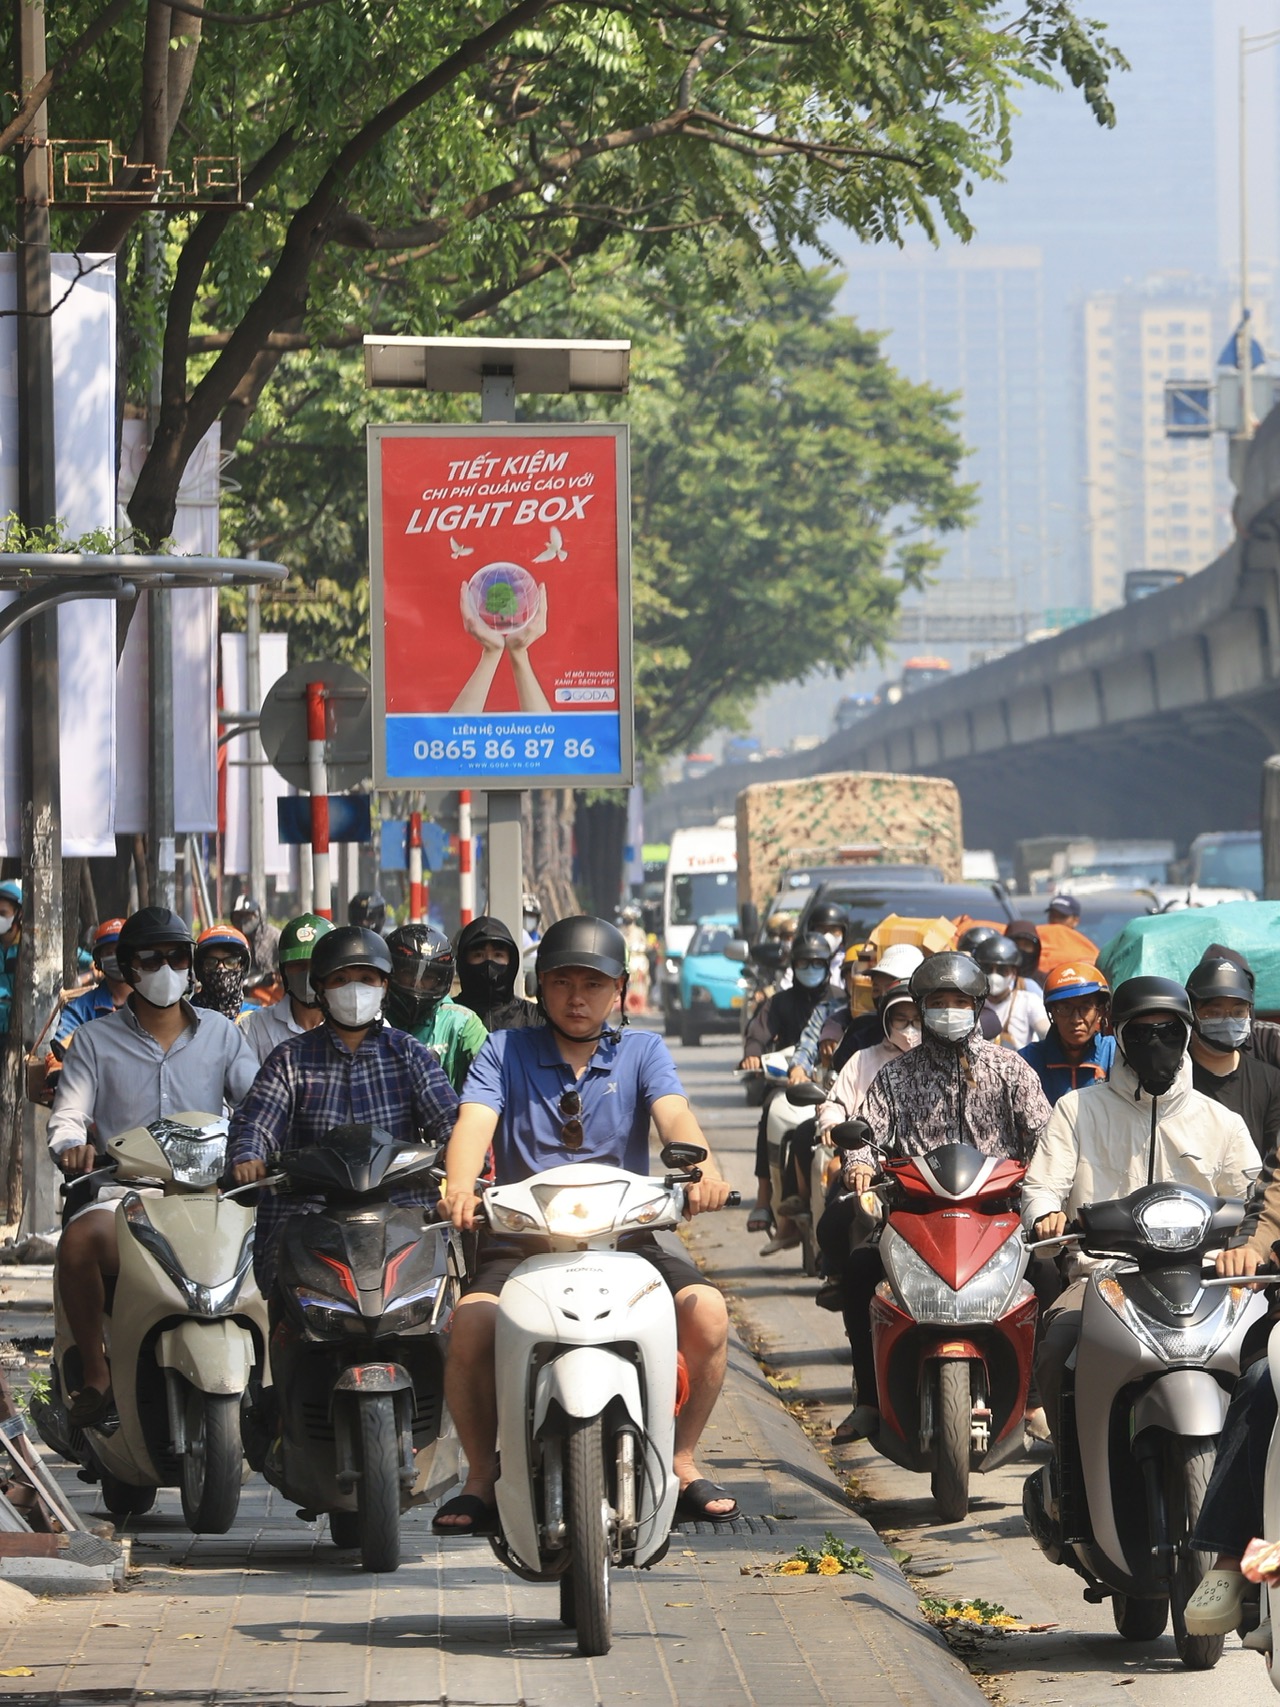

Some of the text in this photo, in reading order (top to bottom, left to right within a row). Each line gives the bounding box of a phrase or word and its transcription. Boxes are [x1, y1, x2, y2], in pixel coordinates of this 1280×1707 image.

[447, 449, 569, 481] TIẾT KIỆM
[422, 472, 595, 501] CHI PHÍ QUẢNG CÁO VỚI
[405, 494, 594, 534] LIGHT BOX
[573, 690, 610, 700] GODA
[452, 723, 555, 737] LIÊN HỆ QUẢNG CÁO
[413, 738, 595, 760] 0865 86 87 86
